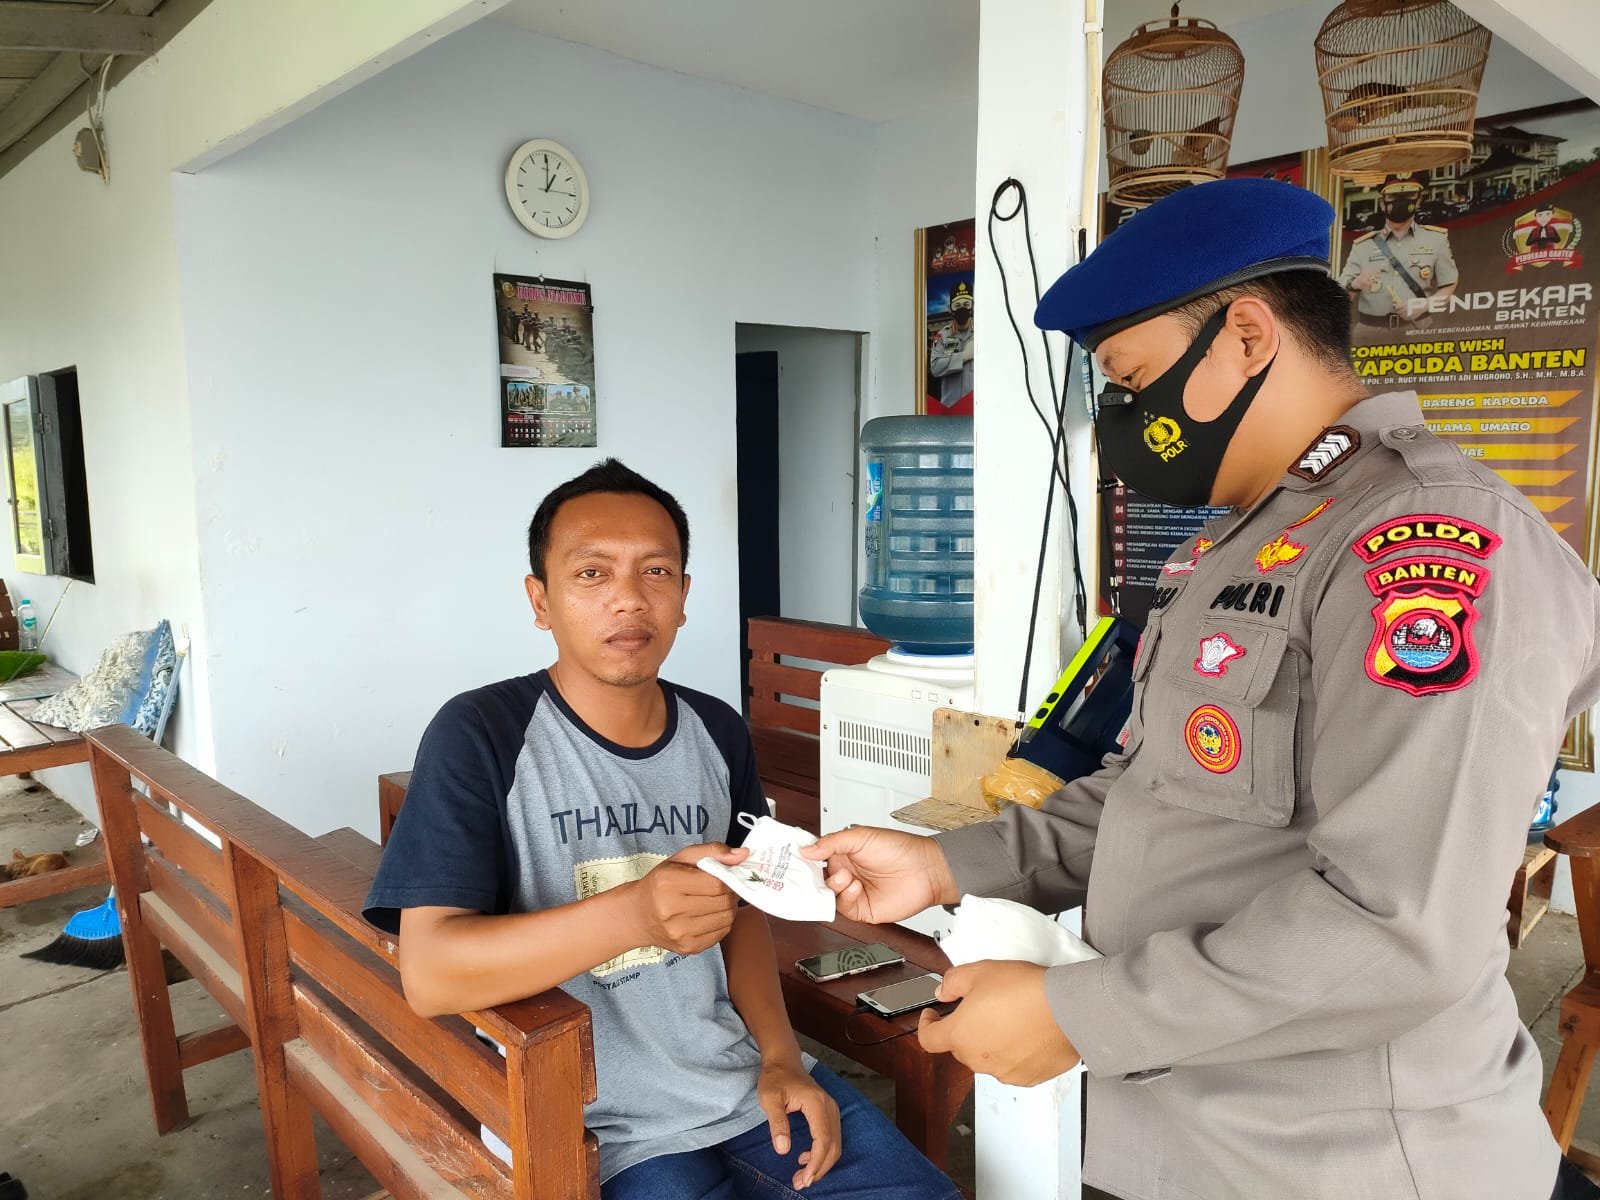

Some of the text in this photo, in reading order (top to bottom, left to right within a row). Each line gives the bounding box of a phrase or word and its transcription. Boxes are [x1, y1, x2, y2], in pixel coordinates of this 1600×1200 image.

[1407, 283, 1592, 317] PENDEKAR
[1496, 303, 1585, 322] BANTEN
[1459, 338, 1505, 353] WISH
[1470, 349, 1586, 372] BANTEN
[1458, 374, 1472, 382] ADI
[1422, 395, 1549, 408] BARENG KAPOLDA
[1428, 421, 1532, 432] ULAMA UMARO
[1115, 505, 1124, 514] 04
[1115, 526, 1124, 534] 05
[1367, 523, 1481, 553] POLDA
[1378, 563, 1477, 586] BANTEN
[551, 802, 710, 845] THAILAND
